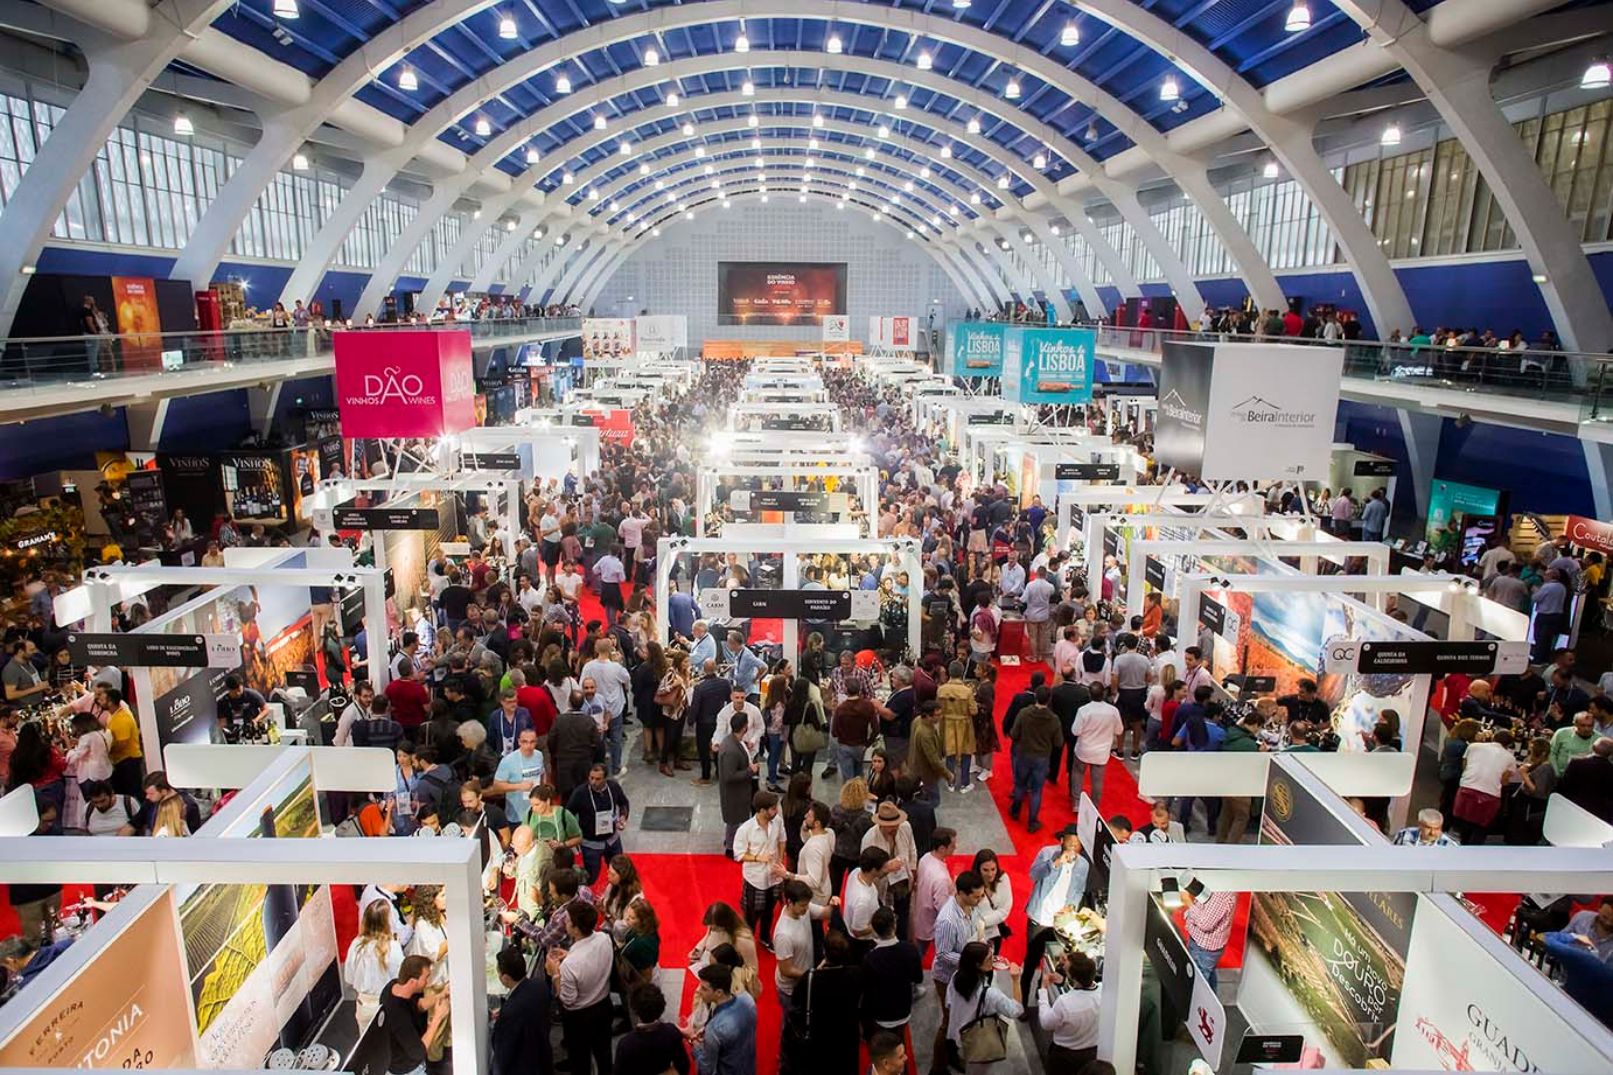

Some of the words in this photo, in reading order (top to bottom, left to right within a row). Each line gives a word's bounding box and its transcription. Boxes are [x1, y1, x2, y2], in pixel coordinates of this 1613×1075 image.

[967, 340, 1000, 354] LISBOA
[1039, 339, 1074, 354] Vinhos
[1039, 353, 1085, 372] LISBOA
[364, 366, 423, 405] DÃO
[346, 397, 379, 405] VINHOS
[408, 396, 436, 405] WINES
[1247, 410, 1316, 423] BeiraInterior
[232, 457, 273, 468] VINHOS
[1333, 937, 1386, 1006] DOURO
[1358, 947, 1371, 963] um
[1367, 964, 1388, 991] novo
[1367, 995, 1384, 1014] por
[77, 1003, 143, 1069] TONIA
[1467, 1003, 1543, 1073] GUAD
